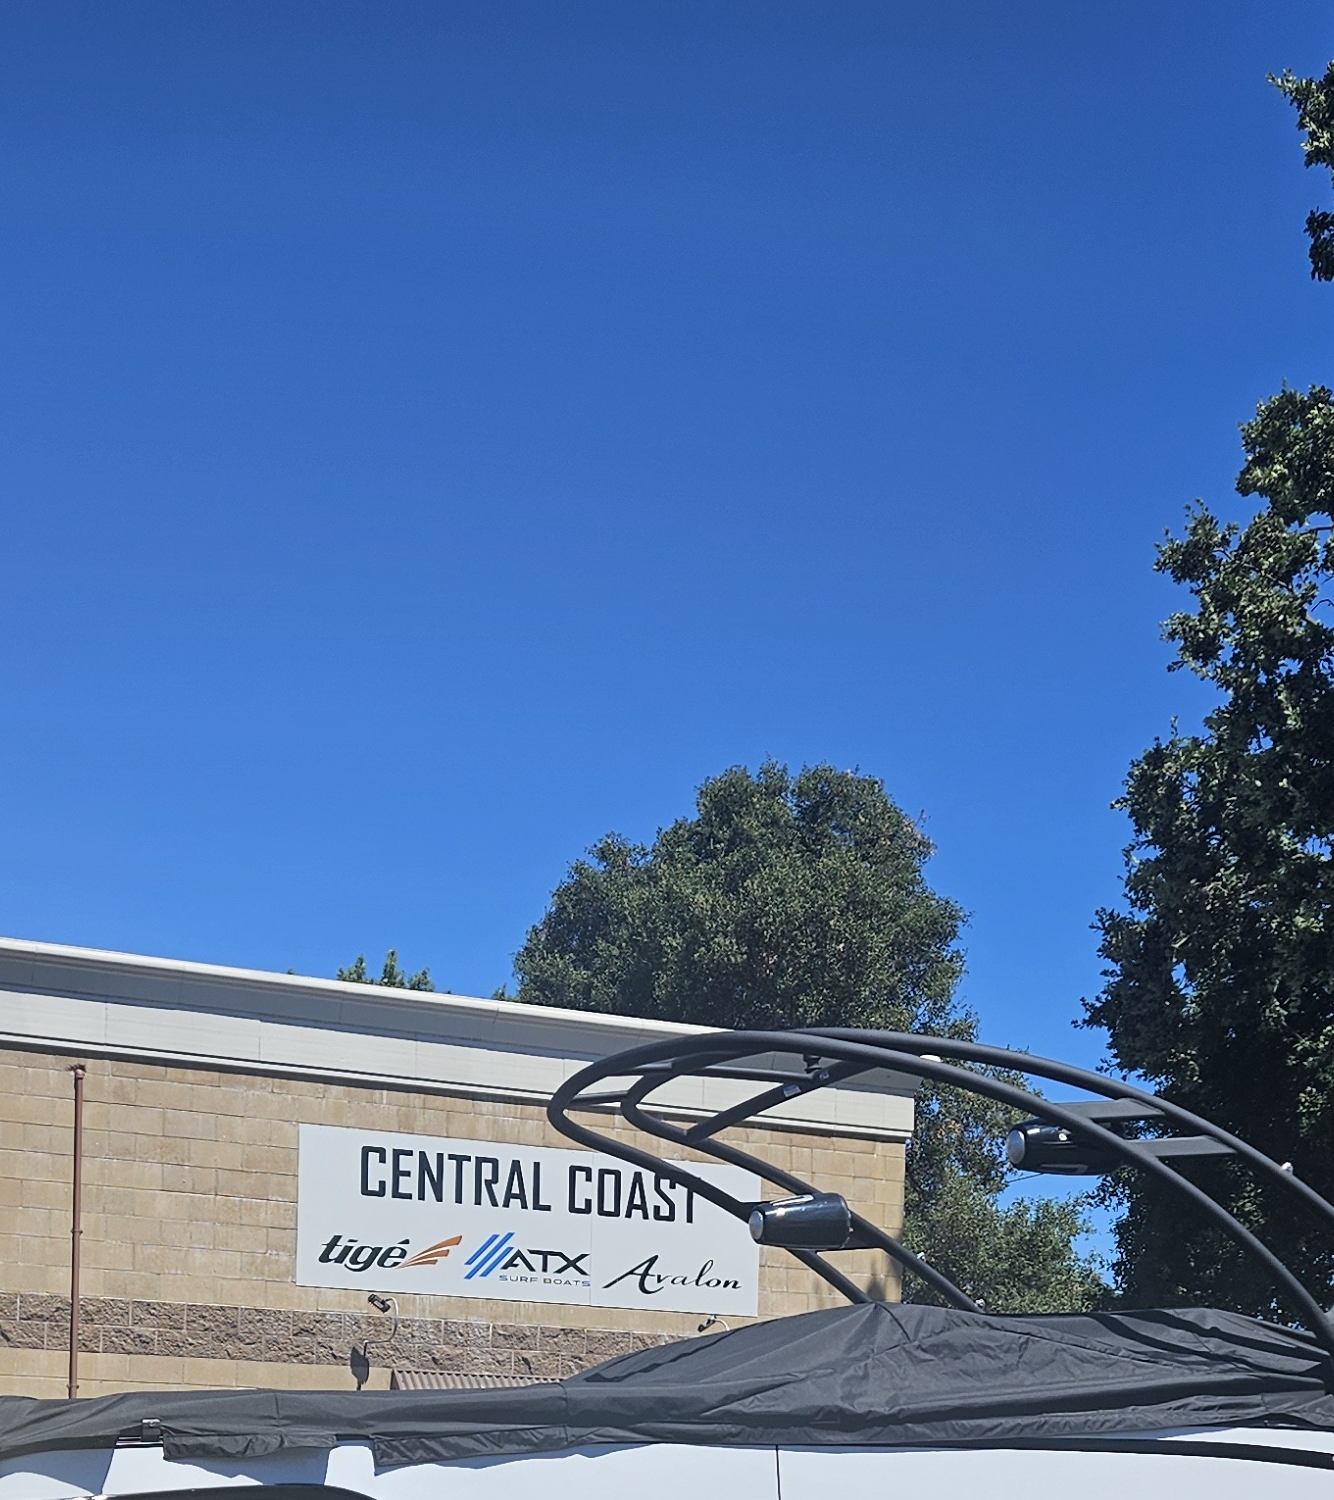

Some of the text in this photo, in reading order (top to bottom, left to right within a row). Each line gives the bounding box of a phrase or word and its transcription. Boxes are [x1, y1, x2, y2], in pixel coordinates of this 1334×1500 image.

[360, 1145, 552, 1212] CENTRAL
[318, 1234, 410, 1273] tigé
[500, 1248, 591, 1276] ATX
[499, 1274, 591, 1287] SURF BOATS
[602, 1254, 742, 1294] Avalon
